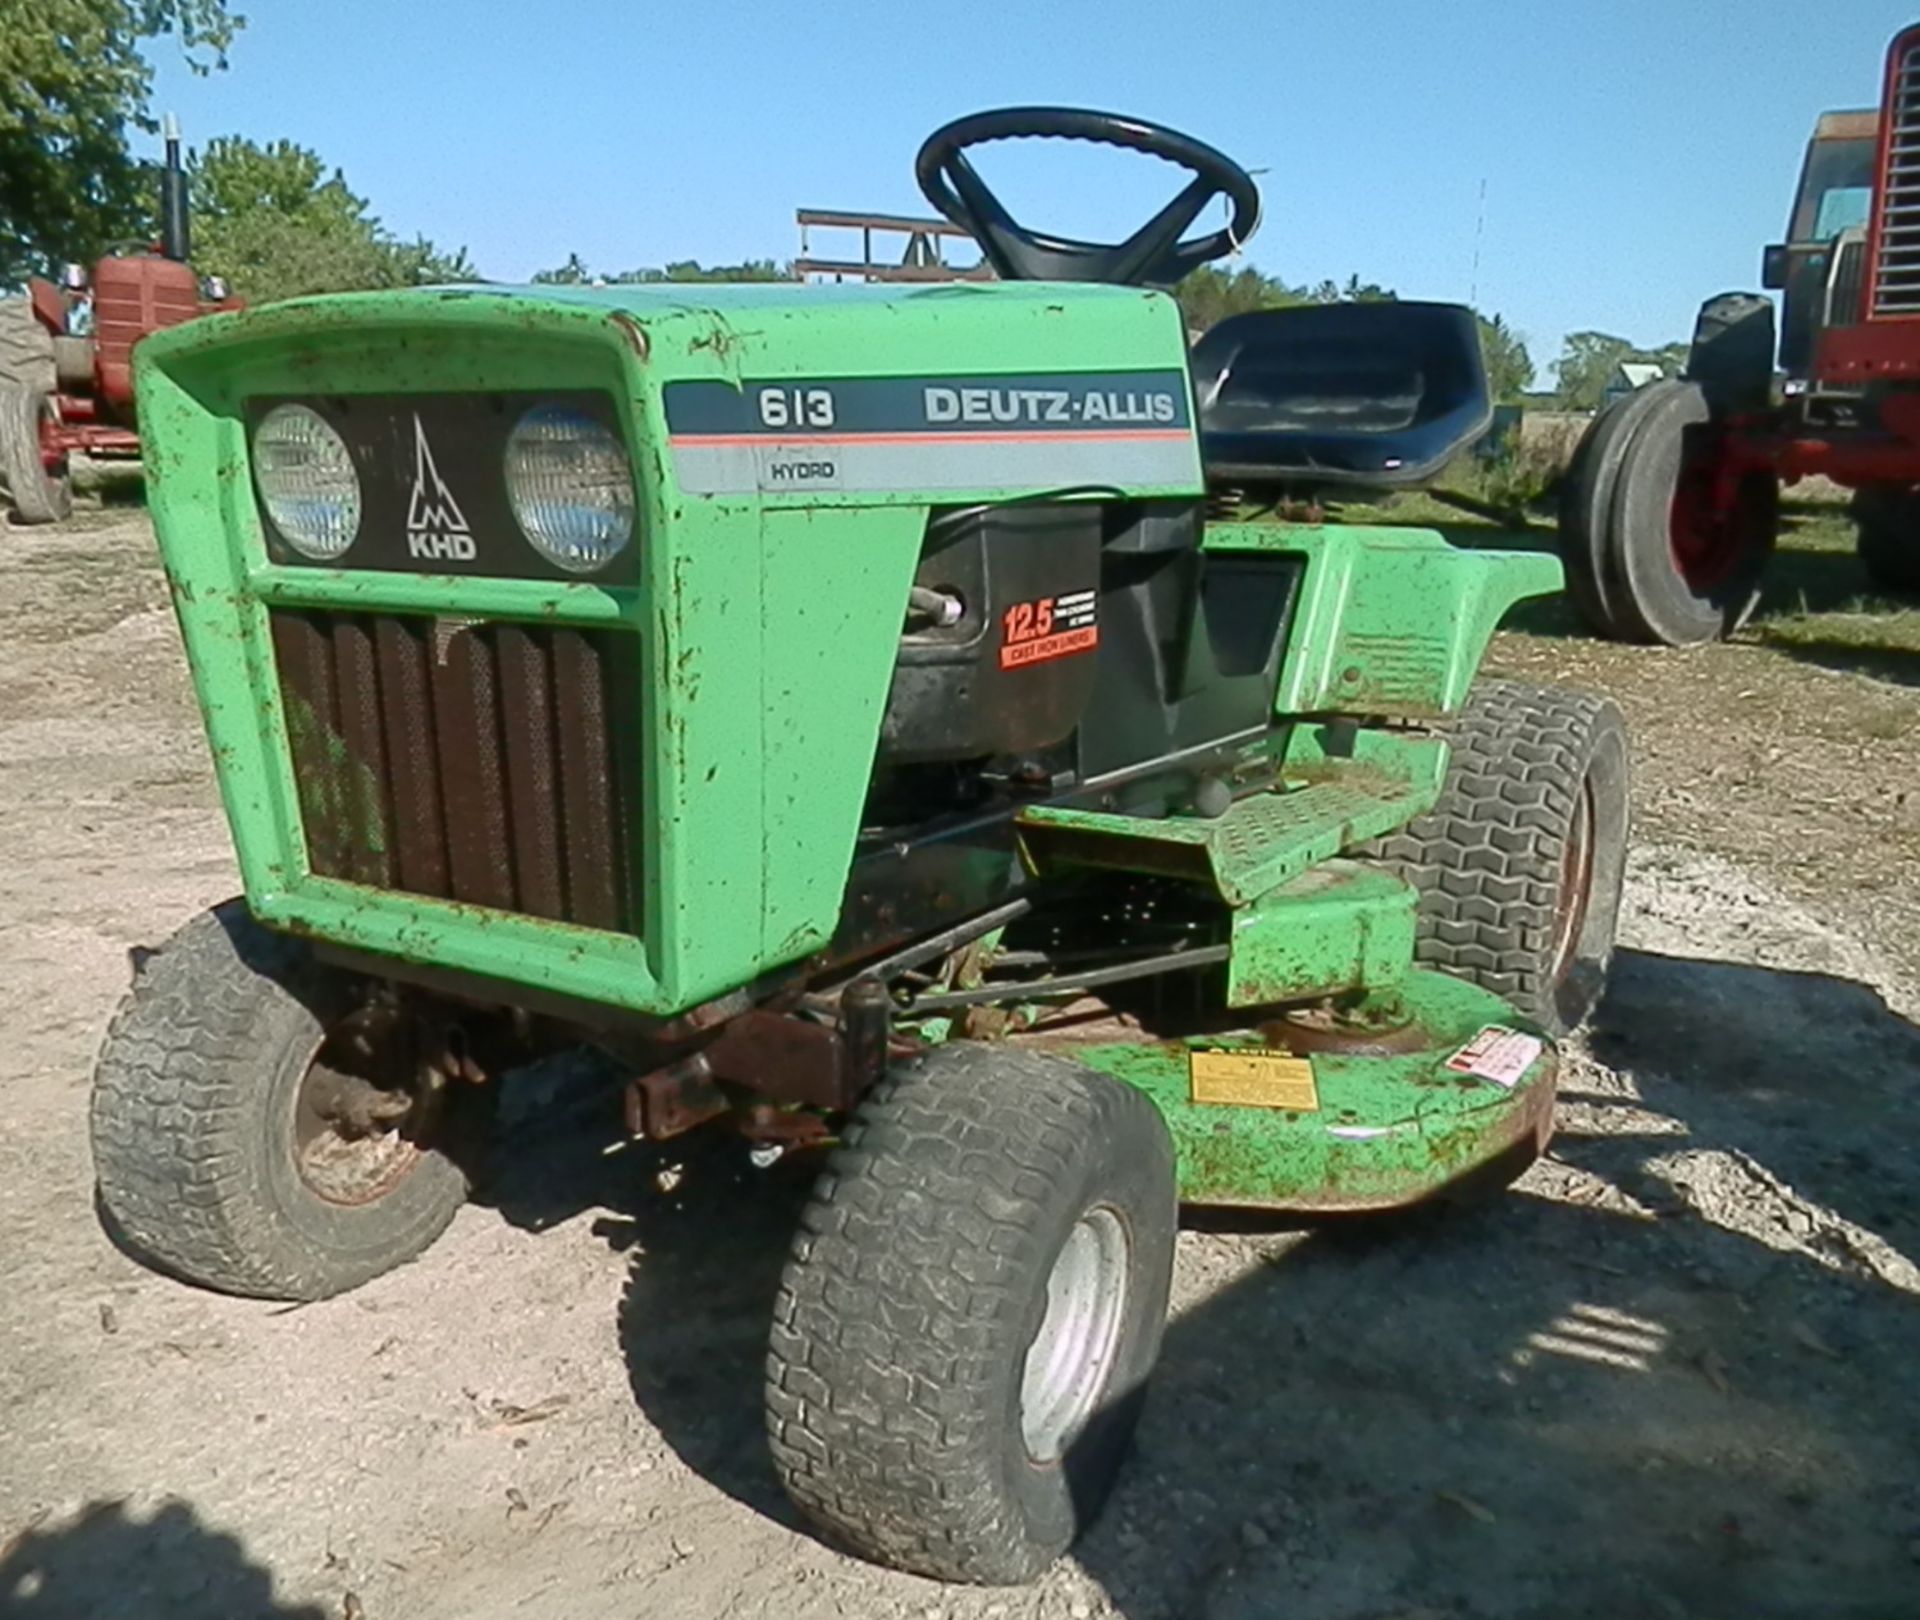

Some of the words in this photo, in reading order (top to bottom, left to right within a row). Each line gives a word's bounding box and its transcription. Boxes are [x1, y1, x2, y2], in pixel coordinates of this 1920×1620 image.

[760, 388, 834, 427] 613
[771, 462, 834, 480] HYDRO
[408, 533, 476, 560] KHD
[1006, 599, 1052, 643] 12.5
[1011, 644, 1034, 661] CAST
[1037, 639, 1058, 654] IRON
